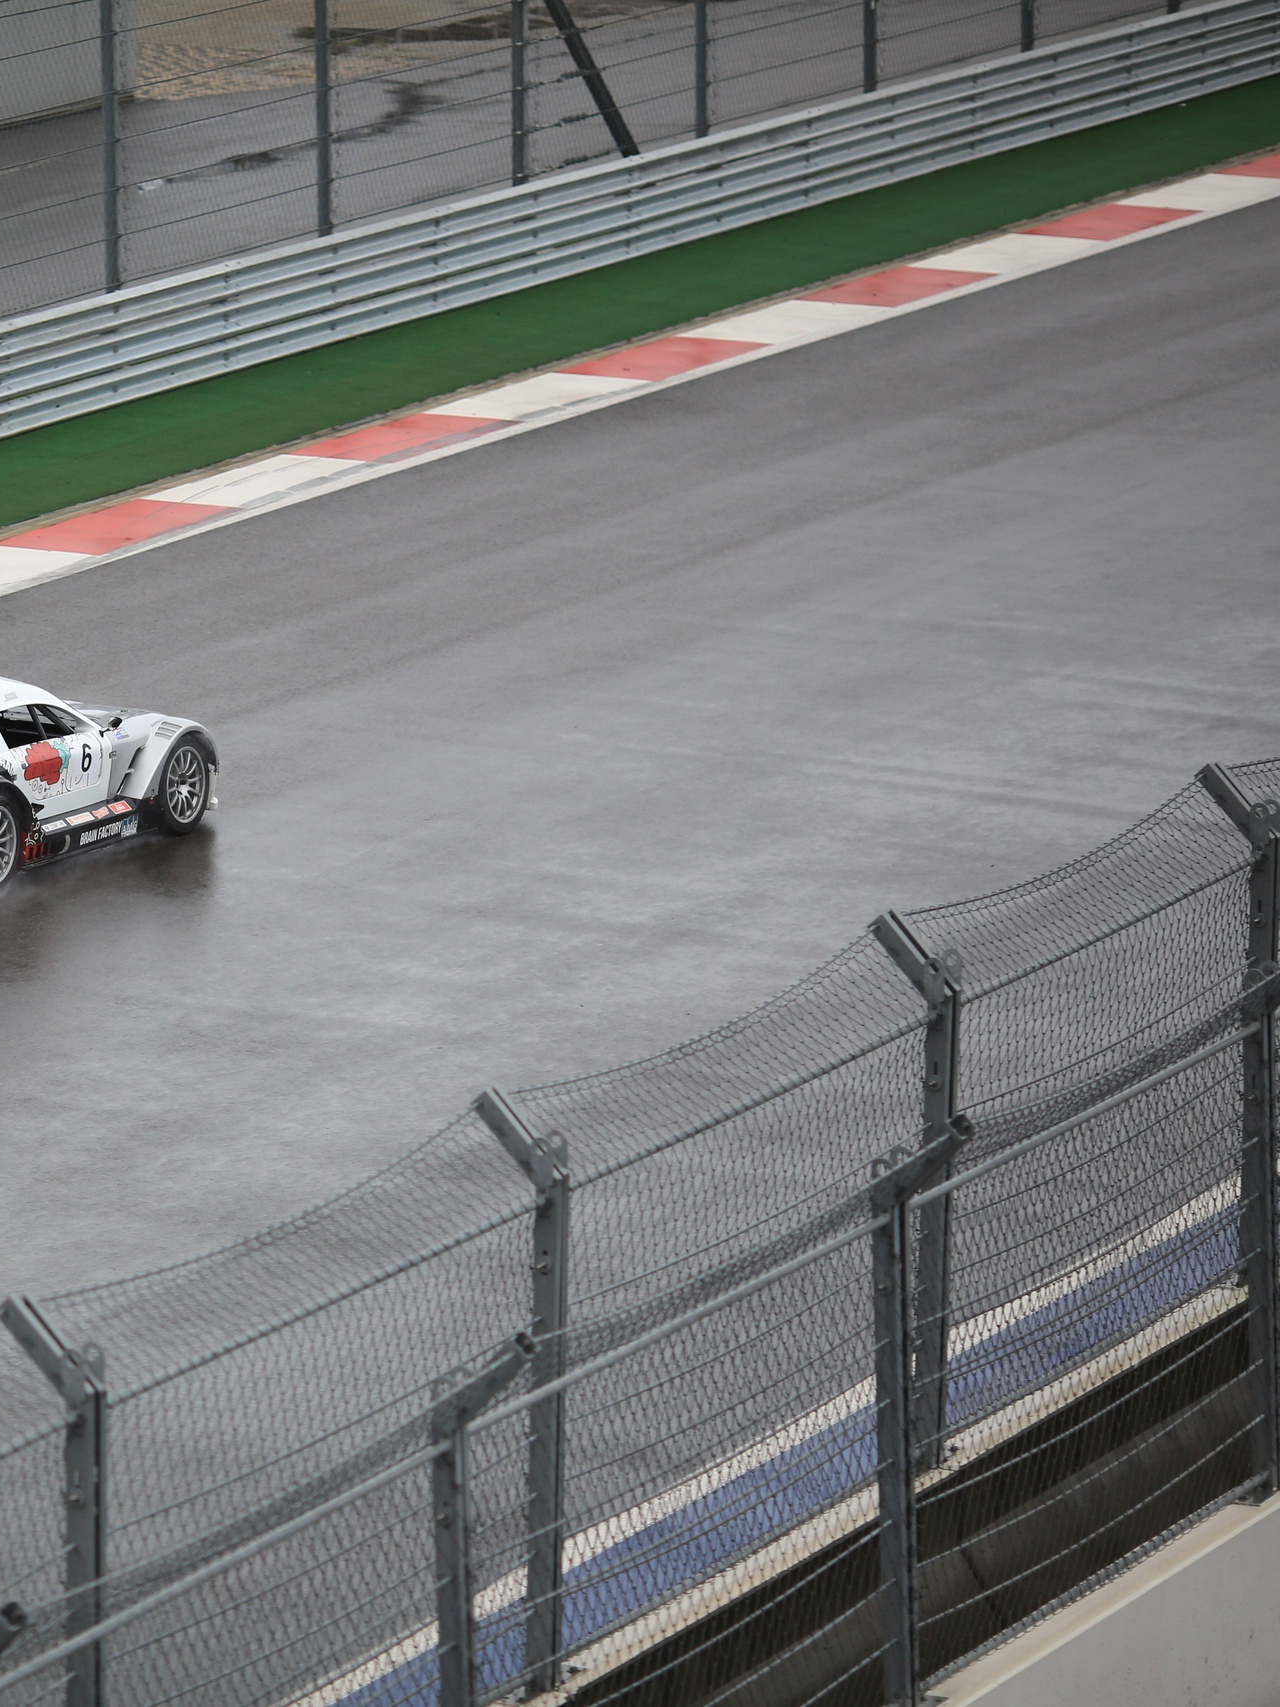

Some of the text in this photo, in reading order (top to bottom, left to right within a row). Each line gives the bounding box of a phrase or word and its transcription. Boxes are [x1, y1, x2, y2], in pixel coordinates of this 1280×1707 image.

[81, 743, 92, 772] 6
[80, 829, 98, 846] BRAIN
[97, 821, 122, 840] FACTORY
